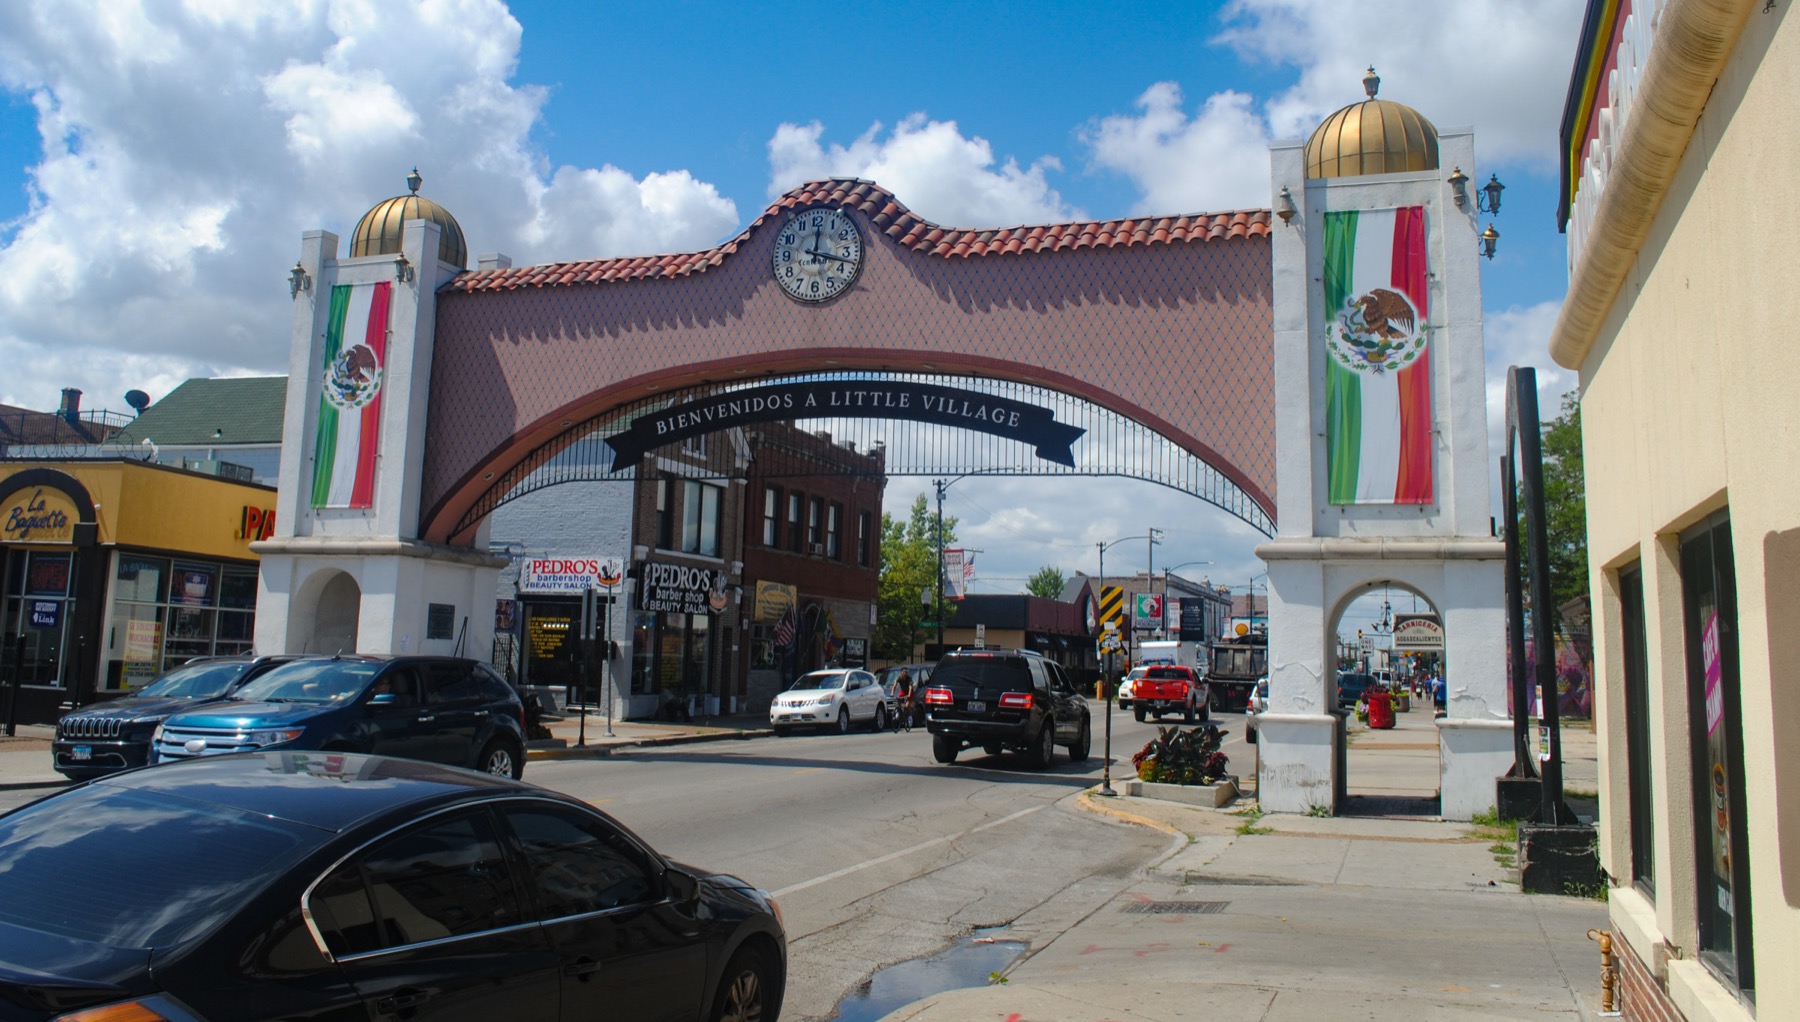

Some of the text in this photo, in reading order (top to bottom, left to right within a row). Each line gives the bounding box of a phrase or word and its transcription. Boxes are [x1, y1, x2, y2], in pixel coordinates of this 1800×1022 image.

[798, 219, 807, 231] 11
[812, 215, 823, 228] 12
[830, 218, 835, 230] 1
[784, 233, 795, 245] 10
[838, 229, 849, 241] 2
[782, 250, 791, 262] 9
[842, 246, 851, 258] 3
[785, 266, 794, 278] 8
[836, 262, 844, 274] 4
[796, 278, 804, 290] 7
[810, 281, 820, 293] 6
[826, 276, 835, 289] 5
[656, 391, 1020, 435] BIENVENIDOS A LITTLE VILLAGE
[27, 488, 45, 512] La
[4, 506, 68, 538] Baguette
[532, 559, 599, 575] PEDRO'S
[537, 574, 592, 583] barbershop
[650, 562, 711, 592] PEDRO'S
[564, 582, 592, 590] SALON
[656, 586, 704, 605] barber shop
[649, 600, 708, 614] BEAUTY SALON
[38, 614, 55, 623] Link
[1399, 620, 1437, 633] CARNICERIA
